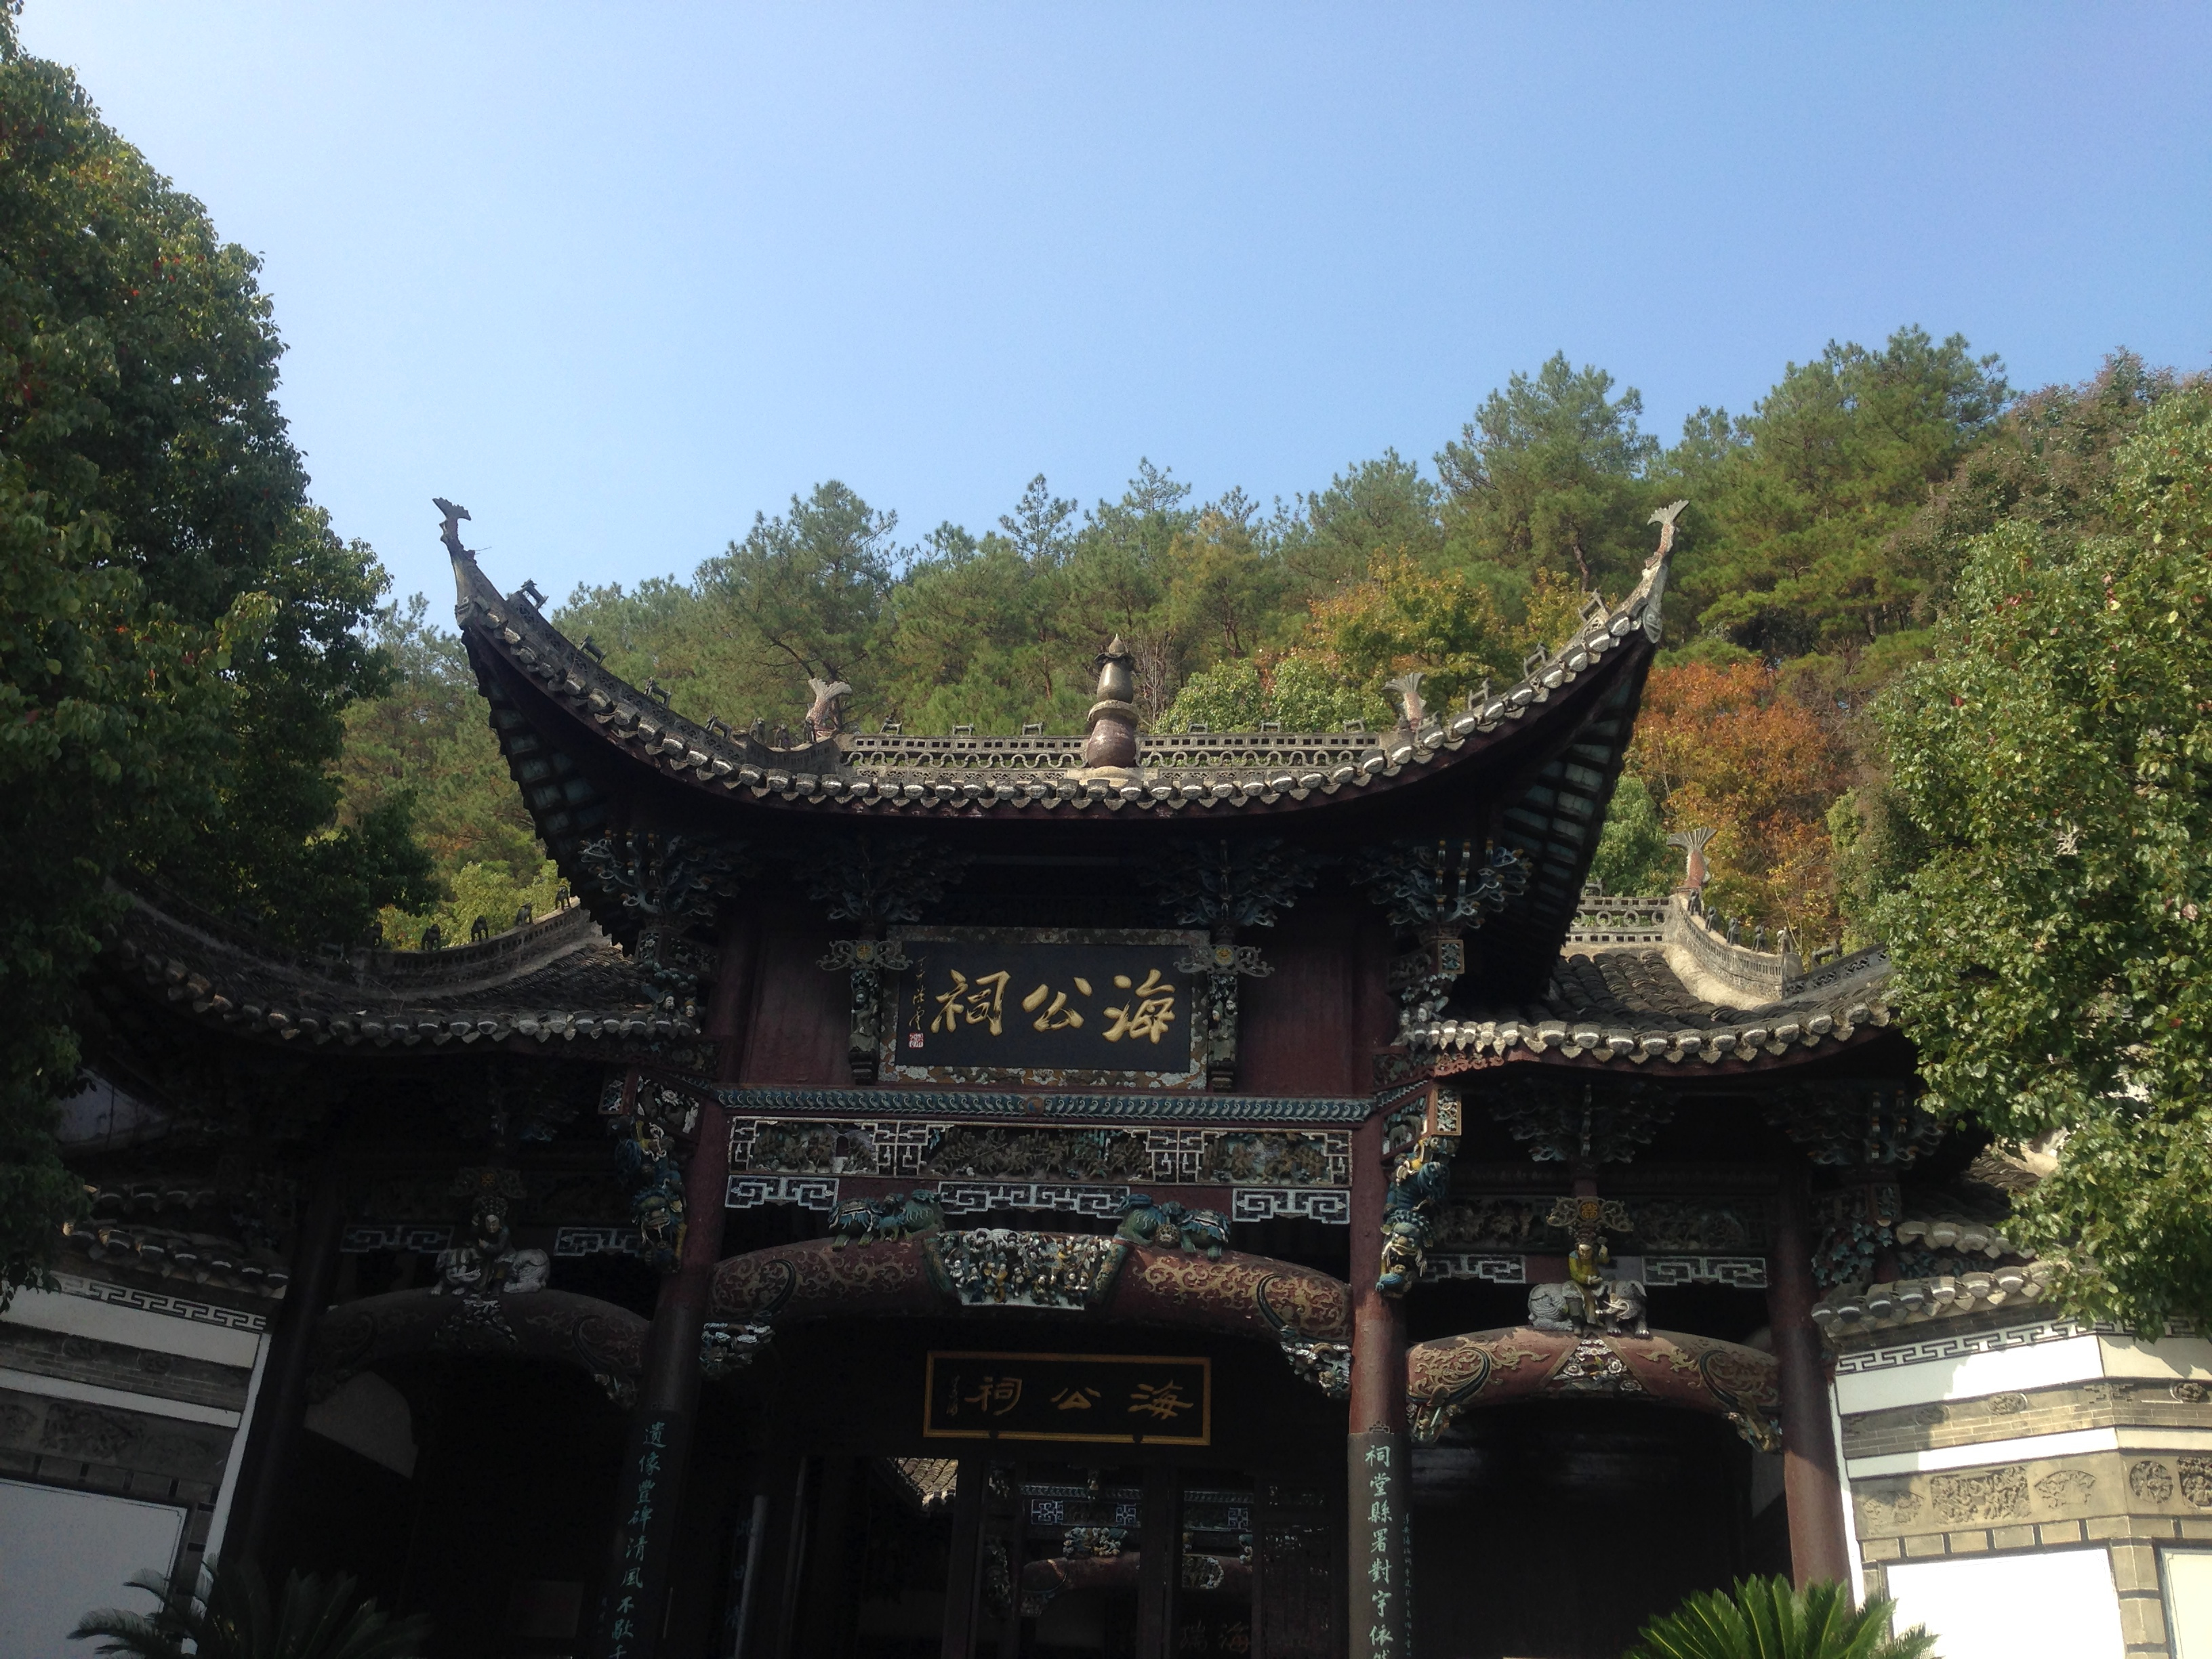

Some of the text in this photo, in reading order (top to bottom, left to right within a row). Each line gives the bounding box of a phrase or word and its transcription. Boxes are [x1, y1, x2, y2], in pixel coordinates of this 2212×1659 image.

[930, 968, 1176, 1044] 海公祠
[964, 1376, 1195, 1420] 海公祠
